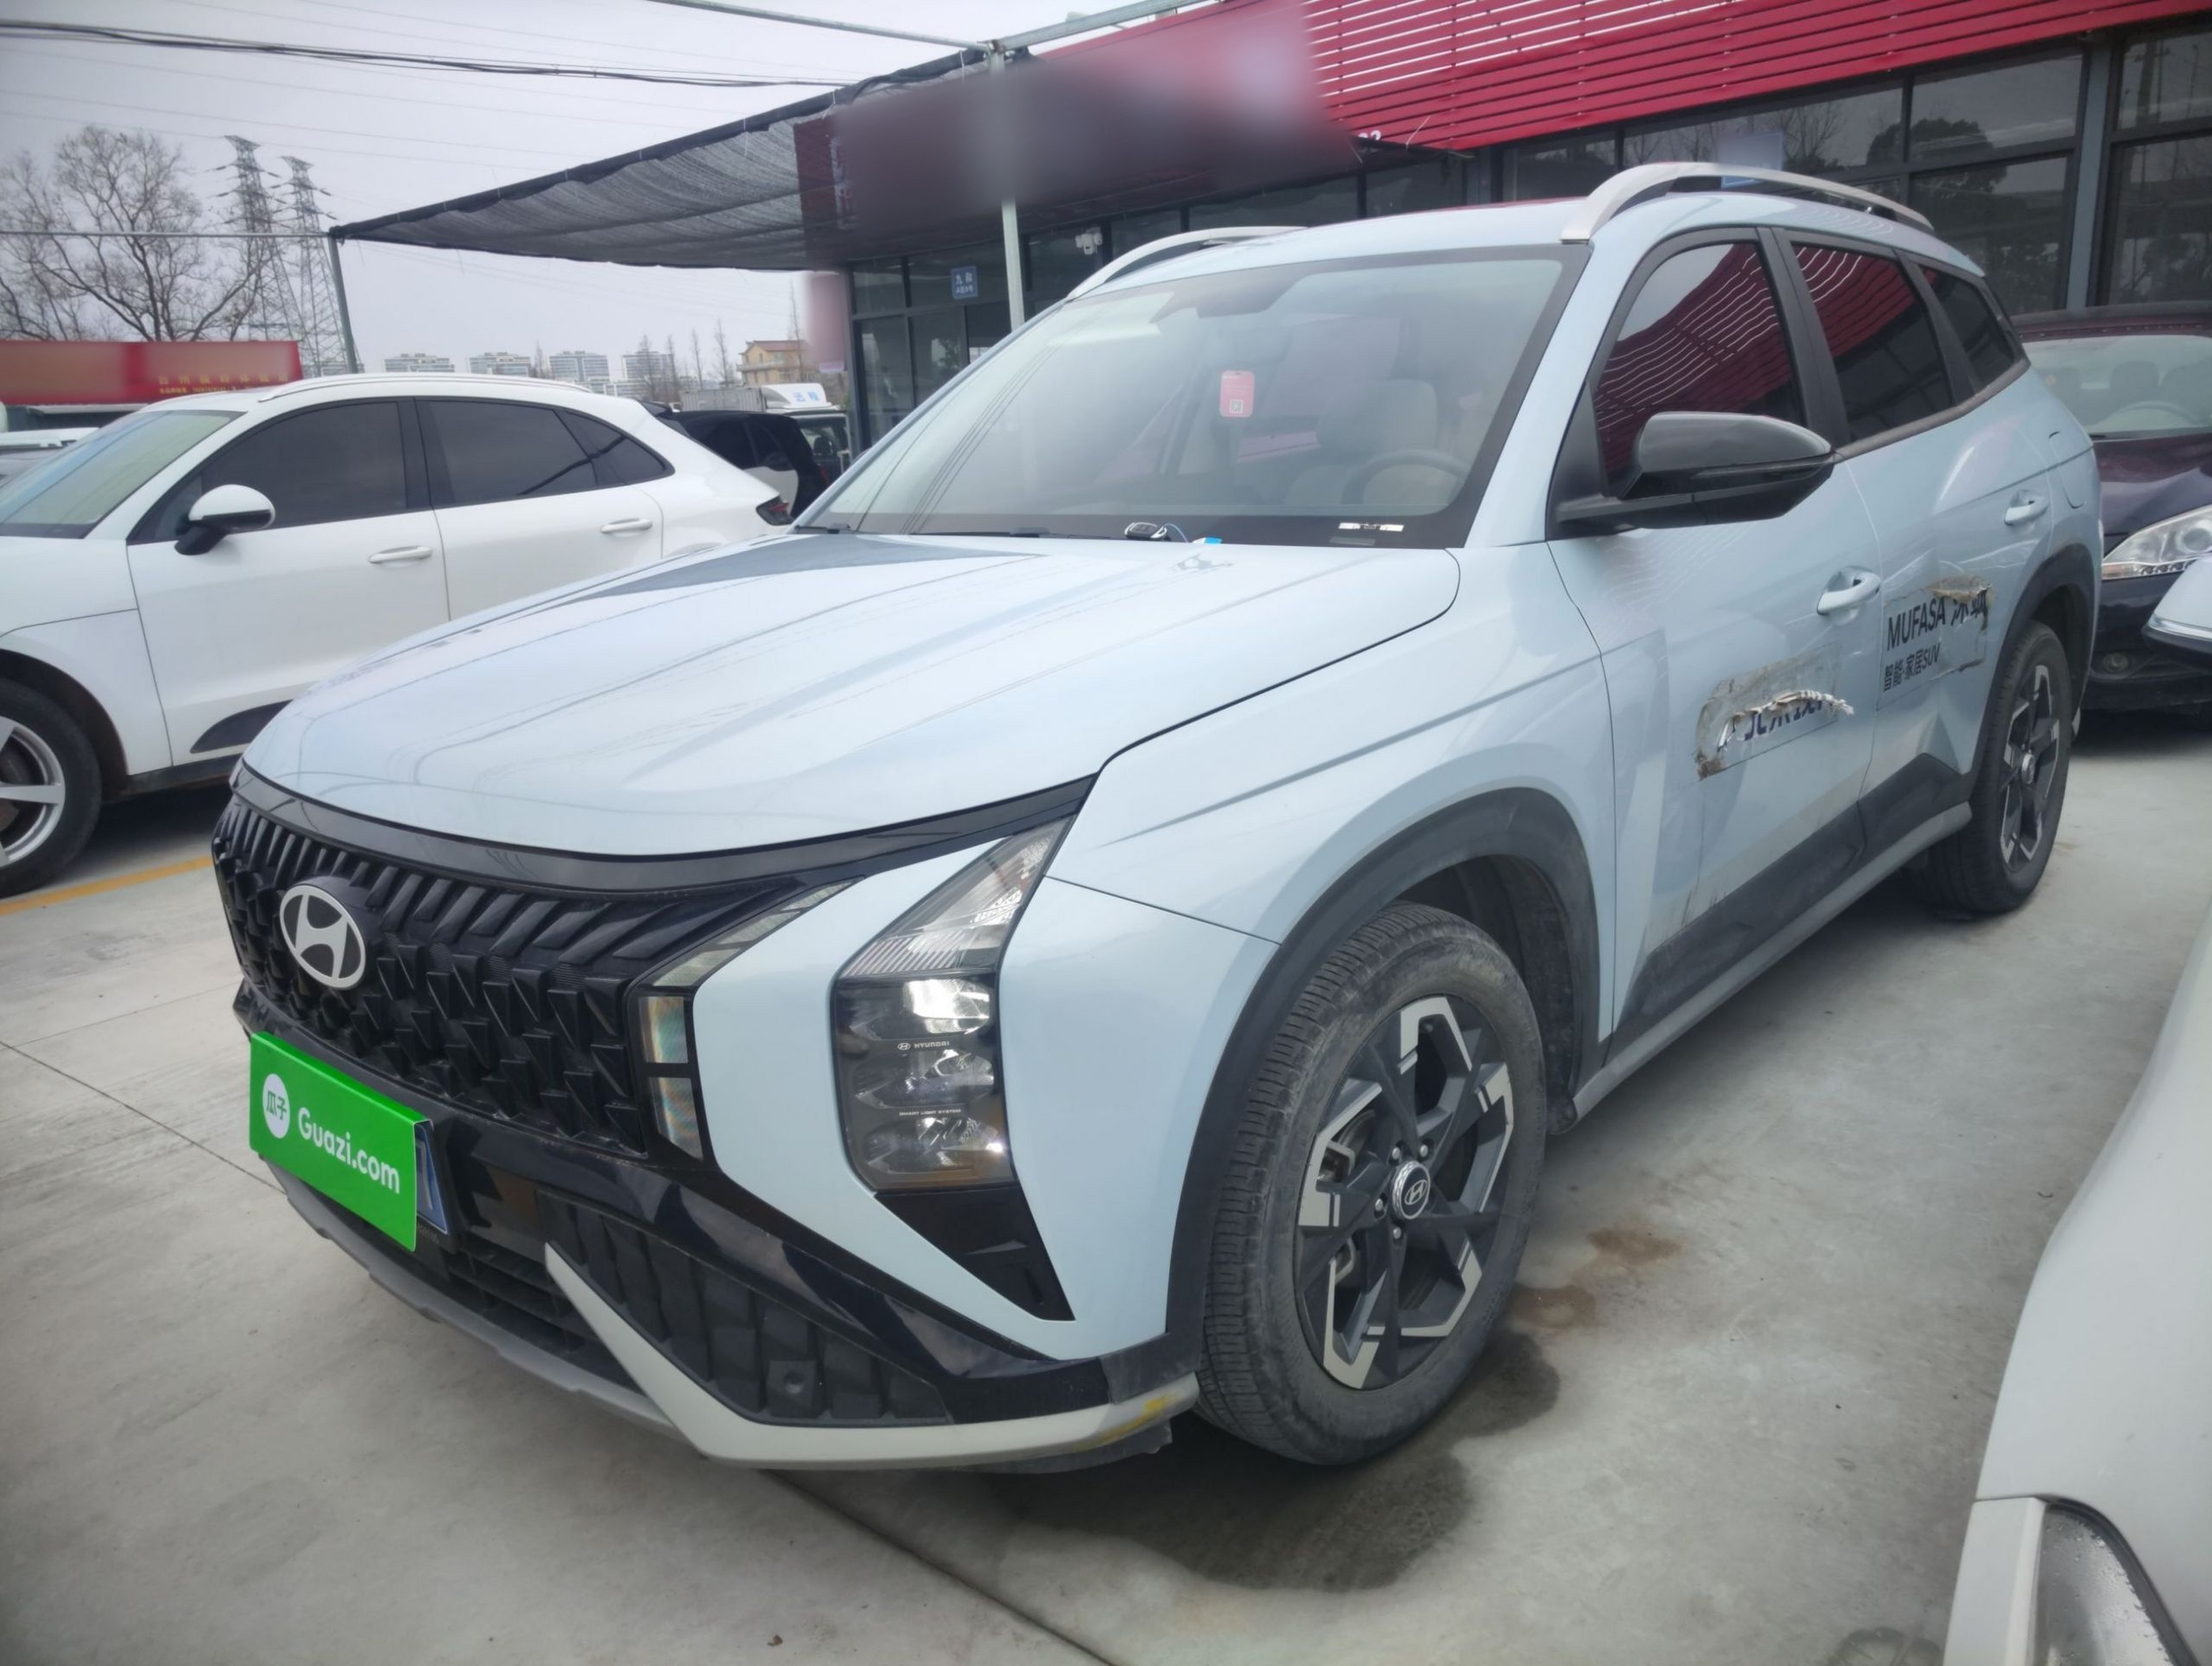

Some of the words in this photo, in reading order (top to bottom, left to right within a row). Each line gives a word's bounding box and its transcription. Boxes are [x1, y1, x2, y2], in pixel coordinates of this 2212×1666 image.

[1887, 596, 1946, 651] MUFASA
[914, 1040, 950, 1048] HYUNDAI
[266, 1091, 287, 1120] 瓜子
[298, 1107, 400, 1195] Guazi.com
